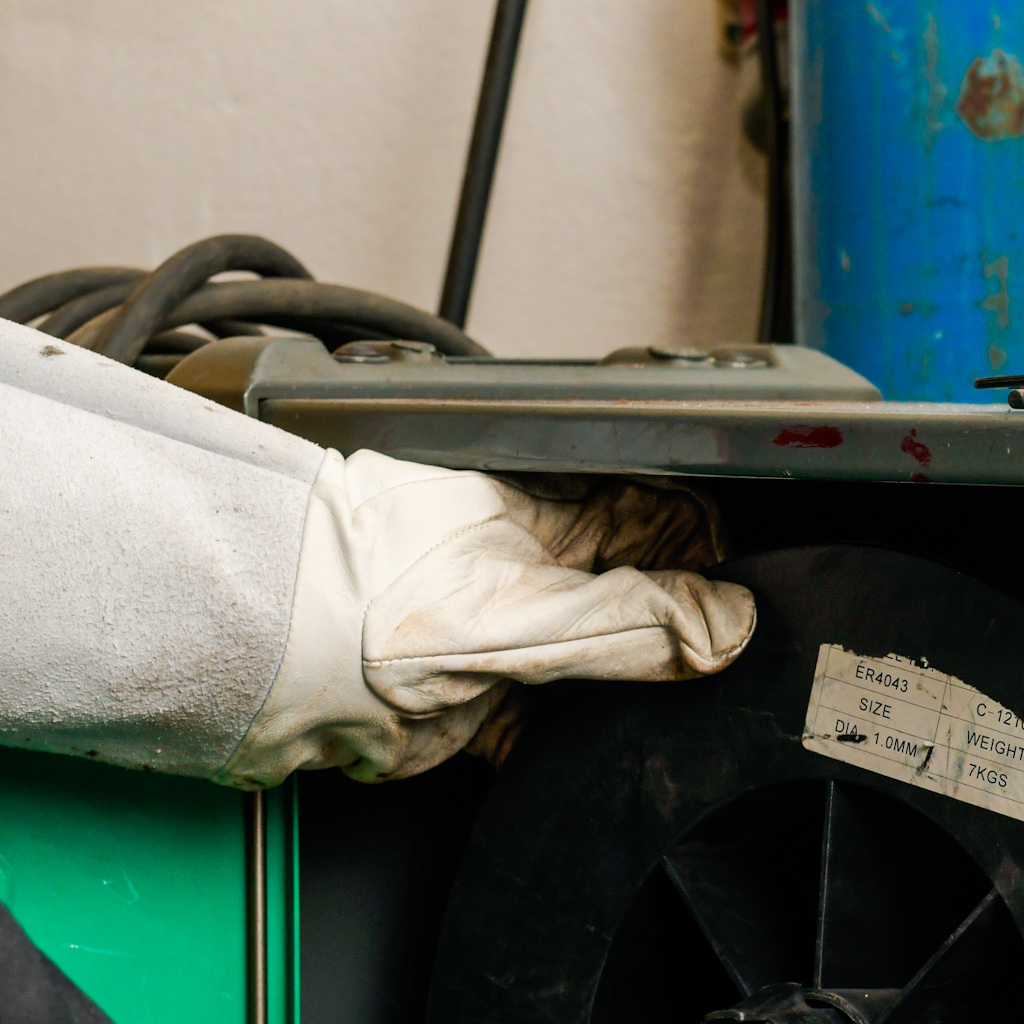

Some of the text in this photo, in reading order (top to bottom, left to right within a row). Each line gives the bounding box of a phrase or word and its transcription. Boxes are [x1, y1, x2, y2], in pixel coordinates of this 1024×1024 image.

[855, 665, 909, 693] ER4043
[859, 697, 892, 719] SIZE
[874, 732, 918, 757] 1.0MM
[969, 763, 1008, 787] 7KGS
